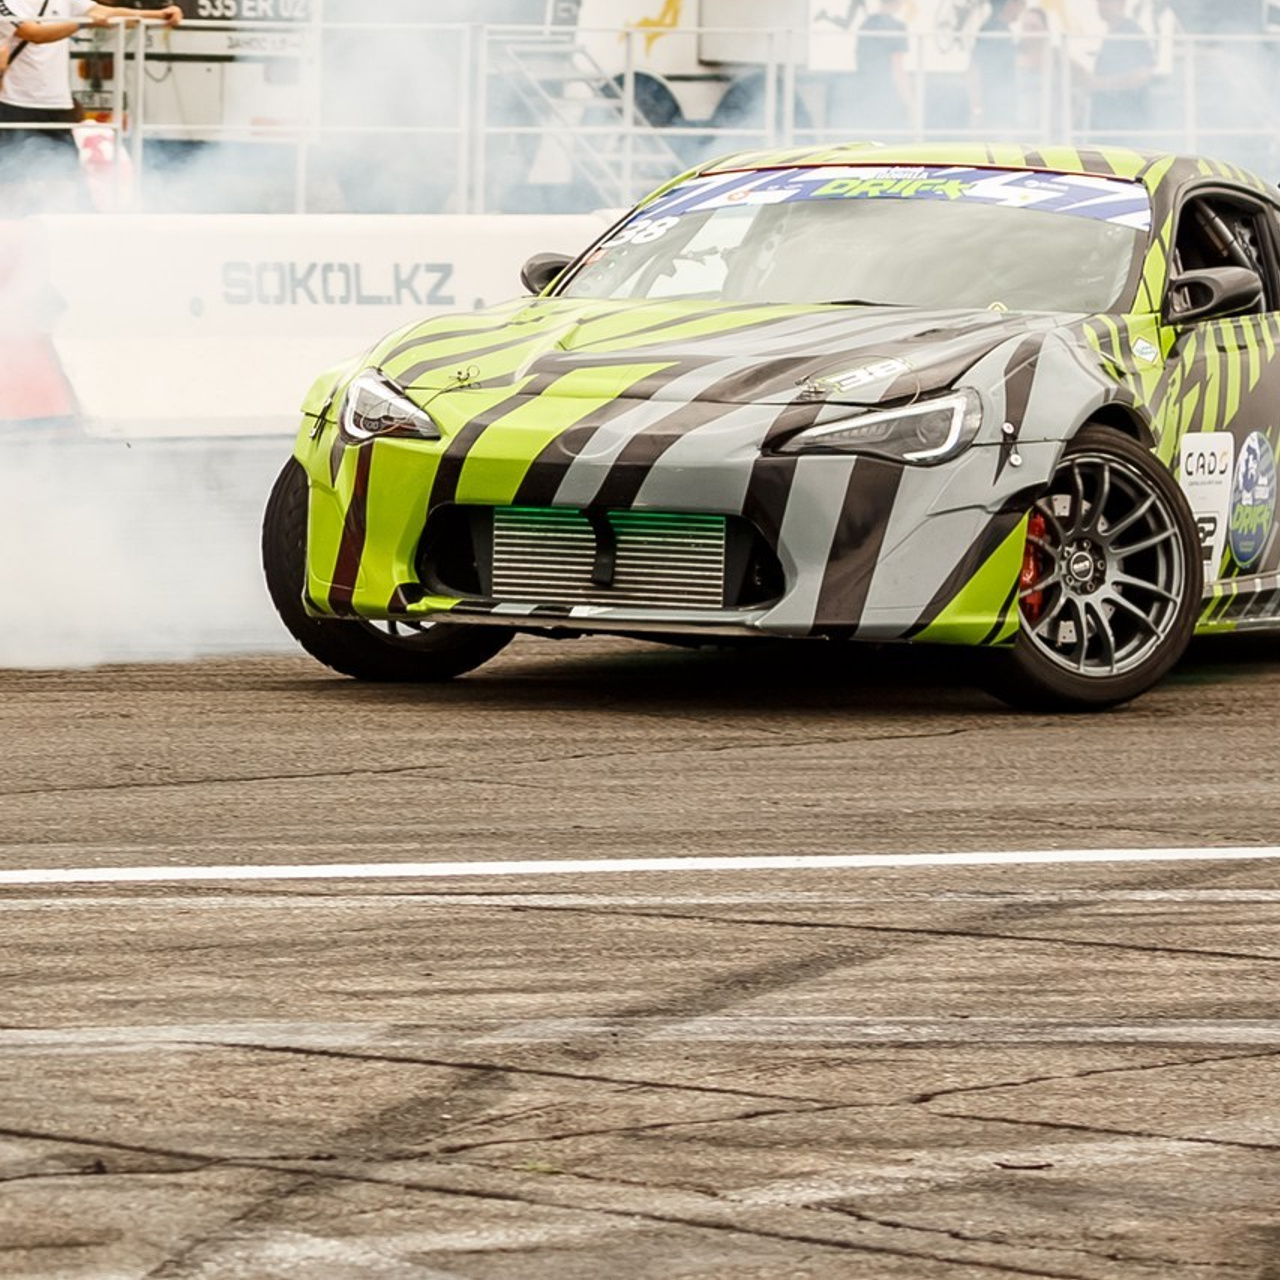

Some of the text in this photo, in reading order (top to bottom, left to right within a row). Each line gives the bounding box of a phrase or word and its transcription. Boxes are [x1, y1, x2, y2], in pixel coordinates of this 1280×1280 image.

[809, 178, 973, 200] DRIFT
[600, 217, 681, 247] 38
[222, 261, 455, 305] SOKOL.KZ
